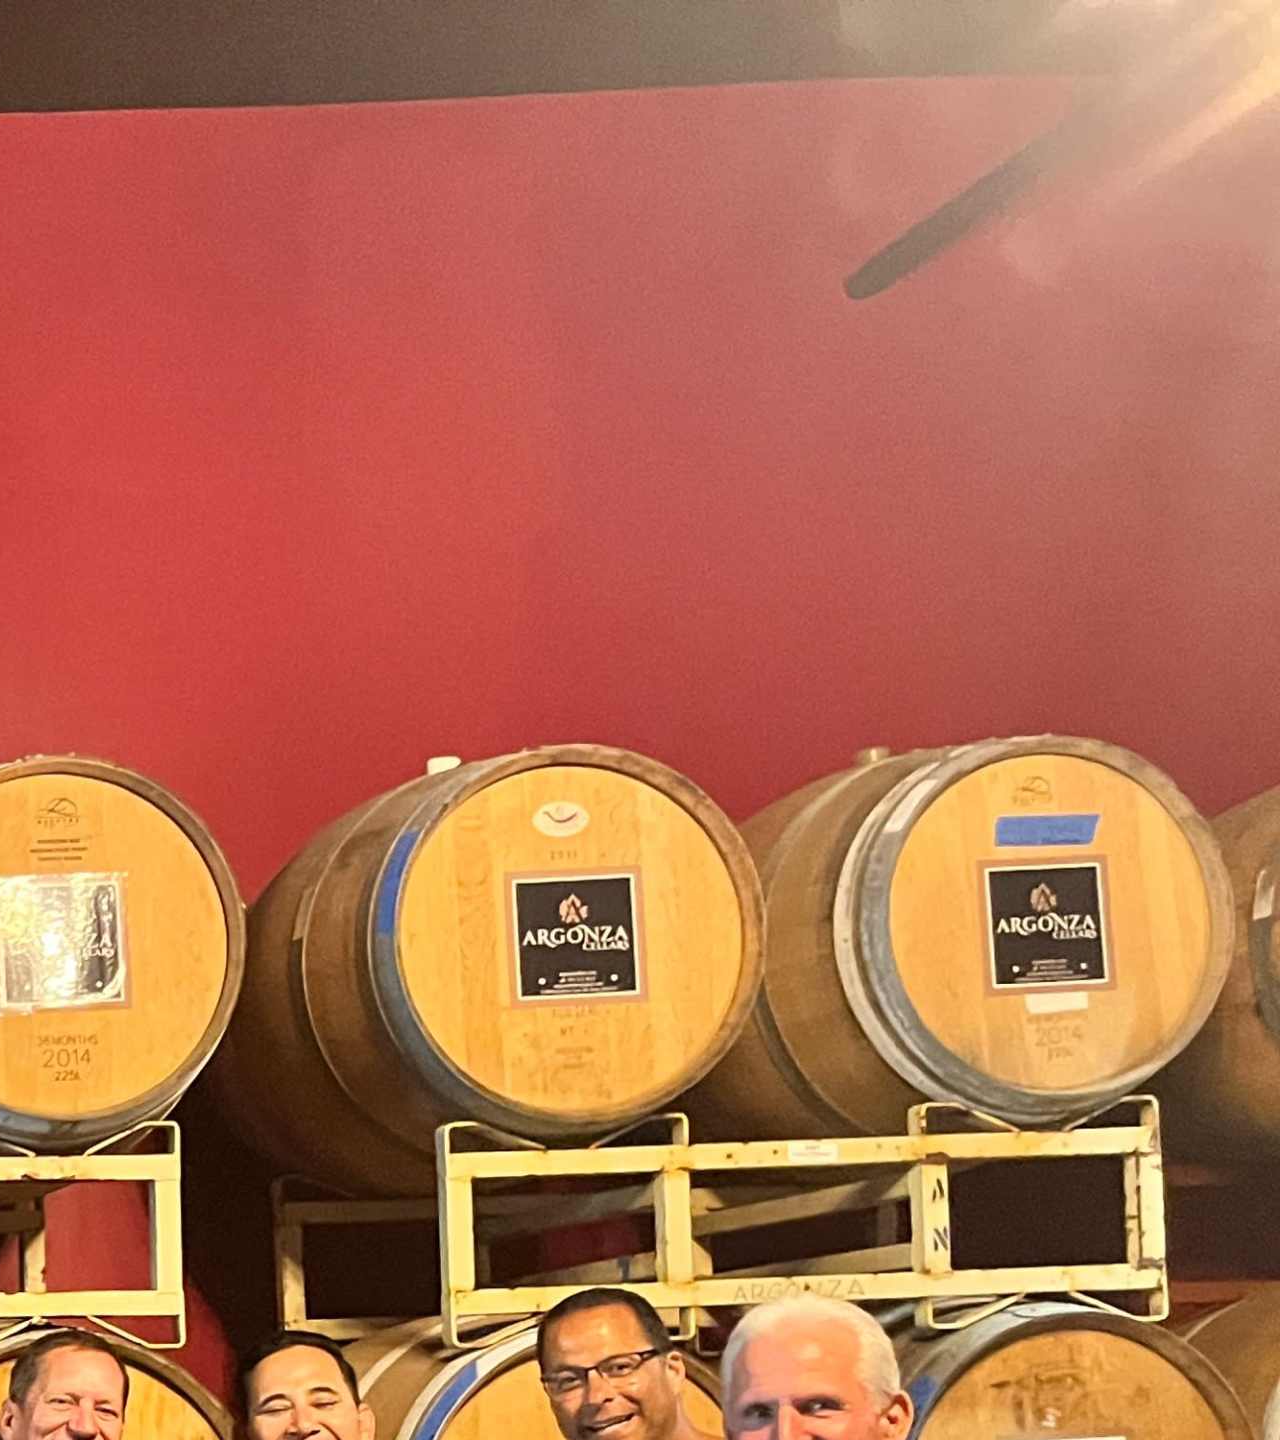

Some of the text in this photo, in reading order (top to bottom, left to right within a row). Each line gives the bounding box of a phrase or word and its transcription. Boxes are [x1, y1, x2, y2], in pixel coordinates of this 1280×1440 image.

[997, 913, 1095, 936] ARGONZA
[522, 924, 629, 948] ARGONZA
[582, 941, 629, 950] CELLARS
[43, 1048, 90, 1068] 2014
